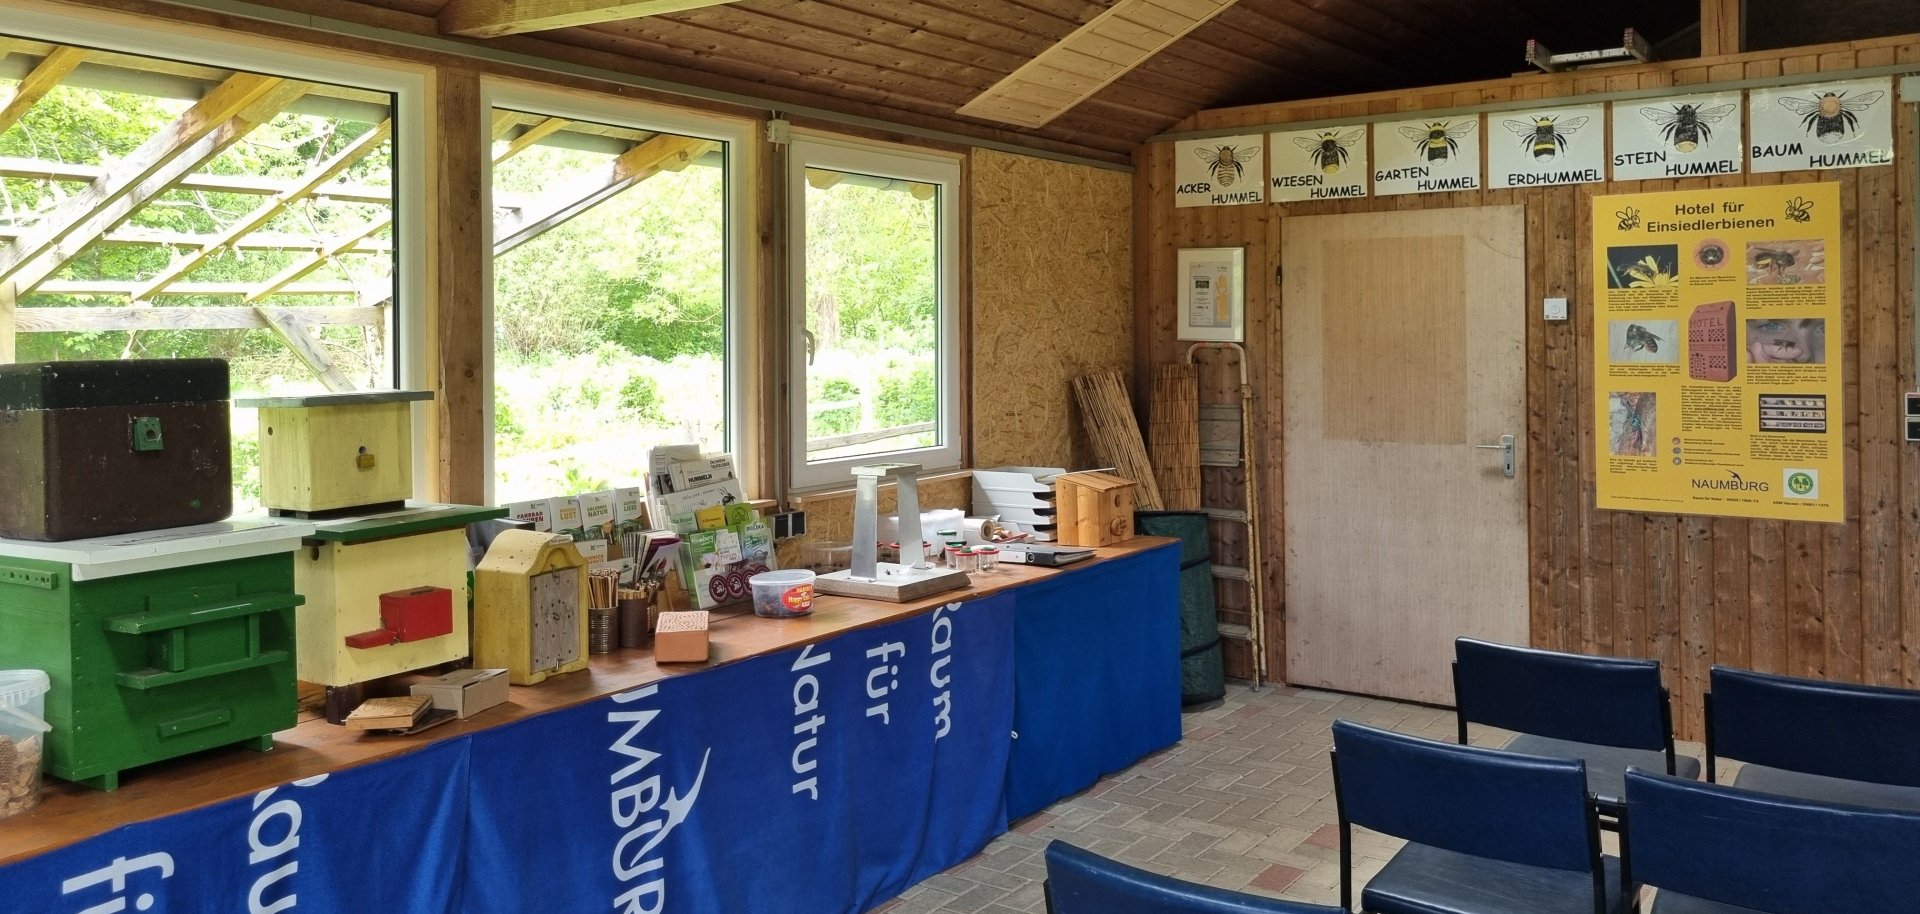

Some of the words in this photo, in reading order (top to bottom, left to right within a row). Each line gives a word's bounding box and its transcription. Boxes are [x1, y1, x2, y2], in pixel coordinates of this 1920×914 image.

[1752, 142, 1803, 158] BAUM
[1614, 150, 1667, 167] STEIN
[1809, 151, 1890, 168] HUMMEL
[1375, 166, 1429, 182] GARTEN
[1665, 160, 1738, 176] HUMMEL
[1272, 175, 1323, 188] WIESEN
[1417, 176, 1477, 191] HUMMEL
[1508, 169, 1602, 186] ERDHUMMEL
[1177, 183, 1211, 194] ACKER
[1310, 185, 1365, 198] HUMMEL
[1211, 192, 1262, 204] HUMMEL
[1675, 202, 1714, 216] Hotel
[1722, 202, 1744, 214] für
[1647, 218, 1775, 233] Einsiedlerbienen
[1691, 478, 1769, 492] NAUMBURG
[517, 511, 543, 519] FAHRRAD
[560, 512, 576, 520] LUST
[588, 509, 608, 517] NATUR
[788, 596, 803, 604] Happy
[866, 641, 905, 725] für
